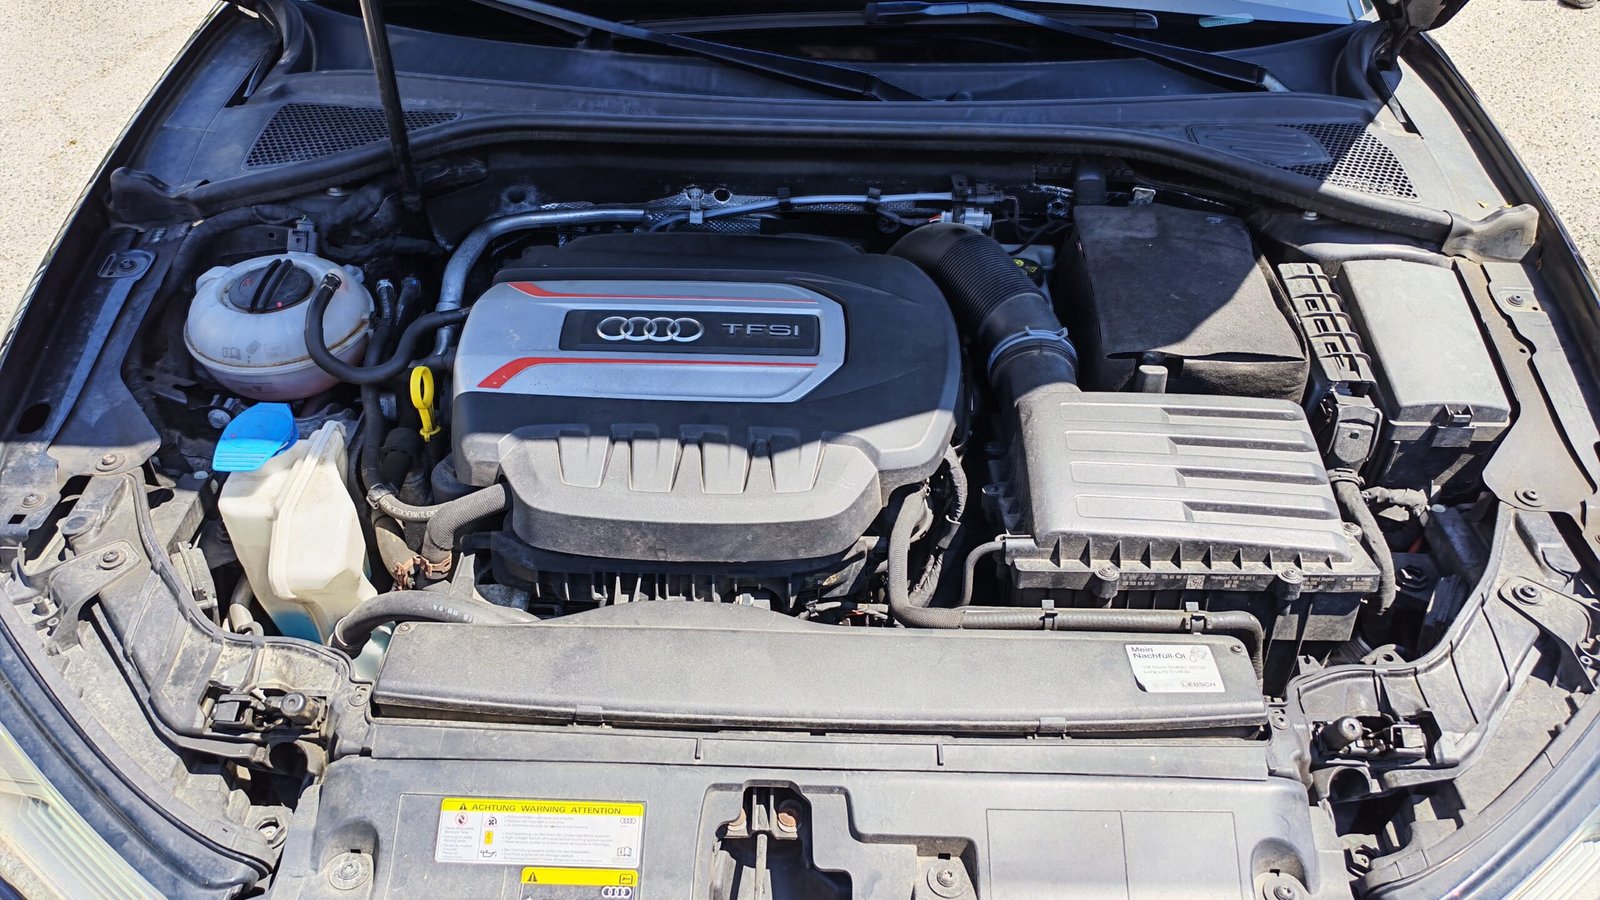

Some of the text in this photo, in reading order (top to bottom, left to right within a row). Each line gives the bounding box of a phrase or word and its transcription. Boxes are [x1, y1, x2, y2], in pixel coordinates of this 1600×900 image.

[721, 323, 799, 336] TFSI
[472, 804, 622, 815] ACHTUNG WARNING ATTENTION
